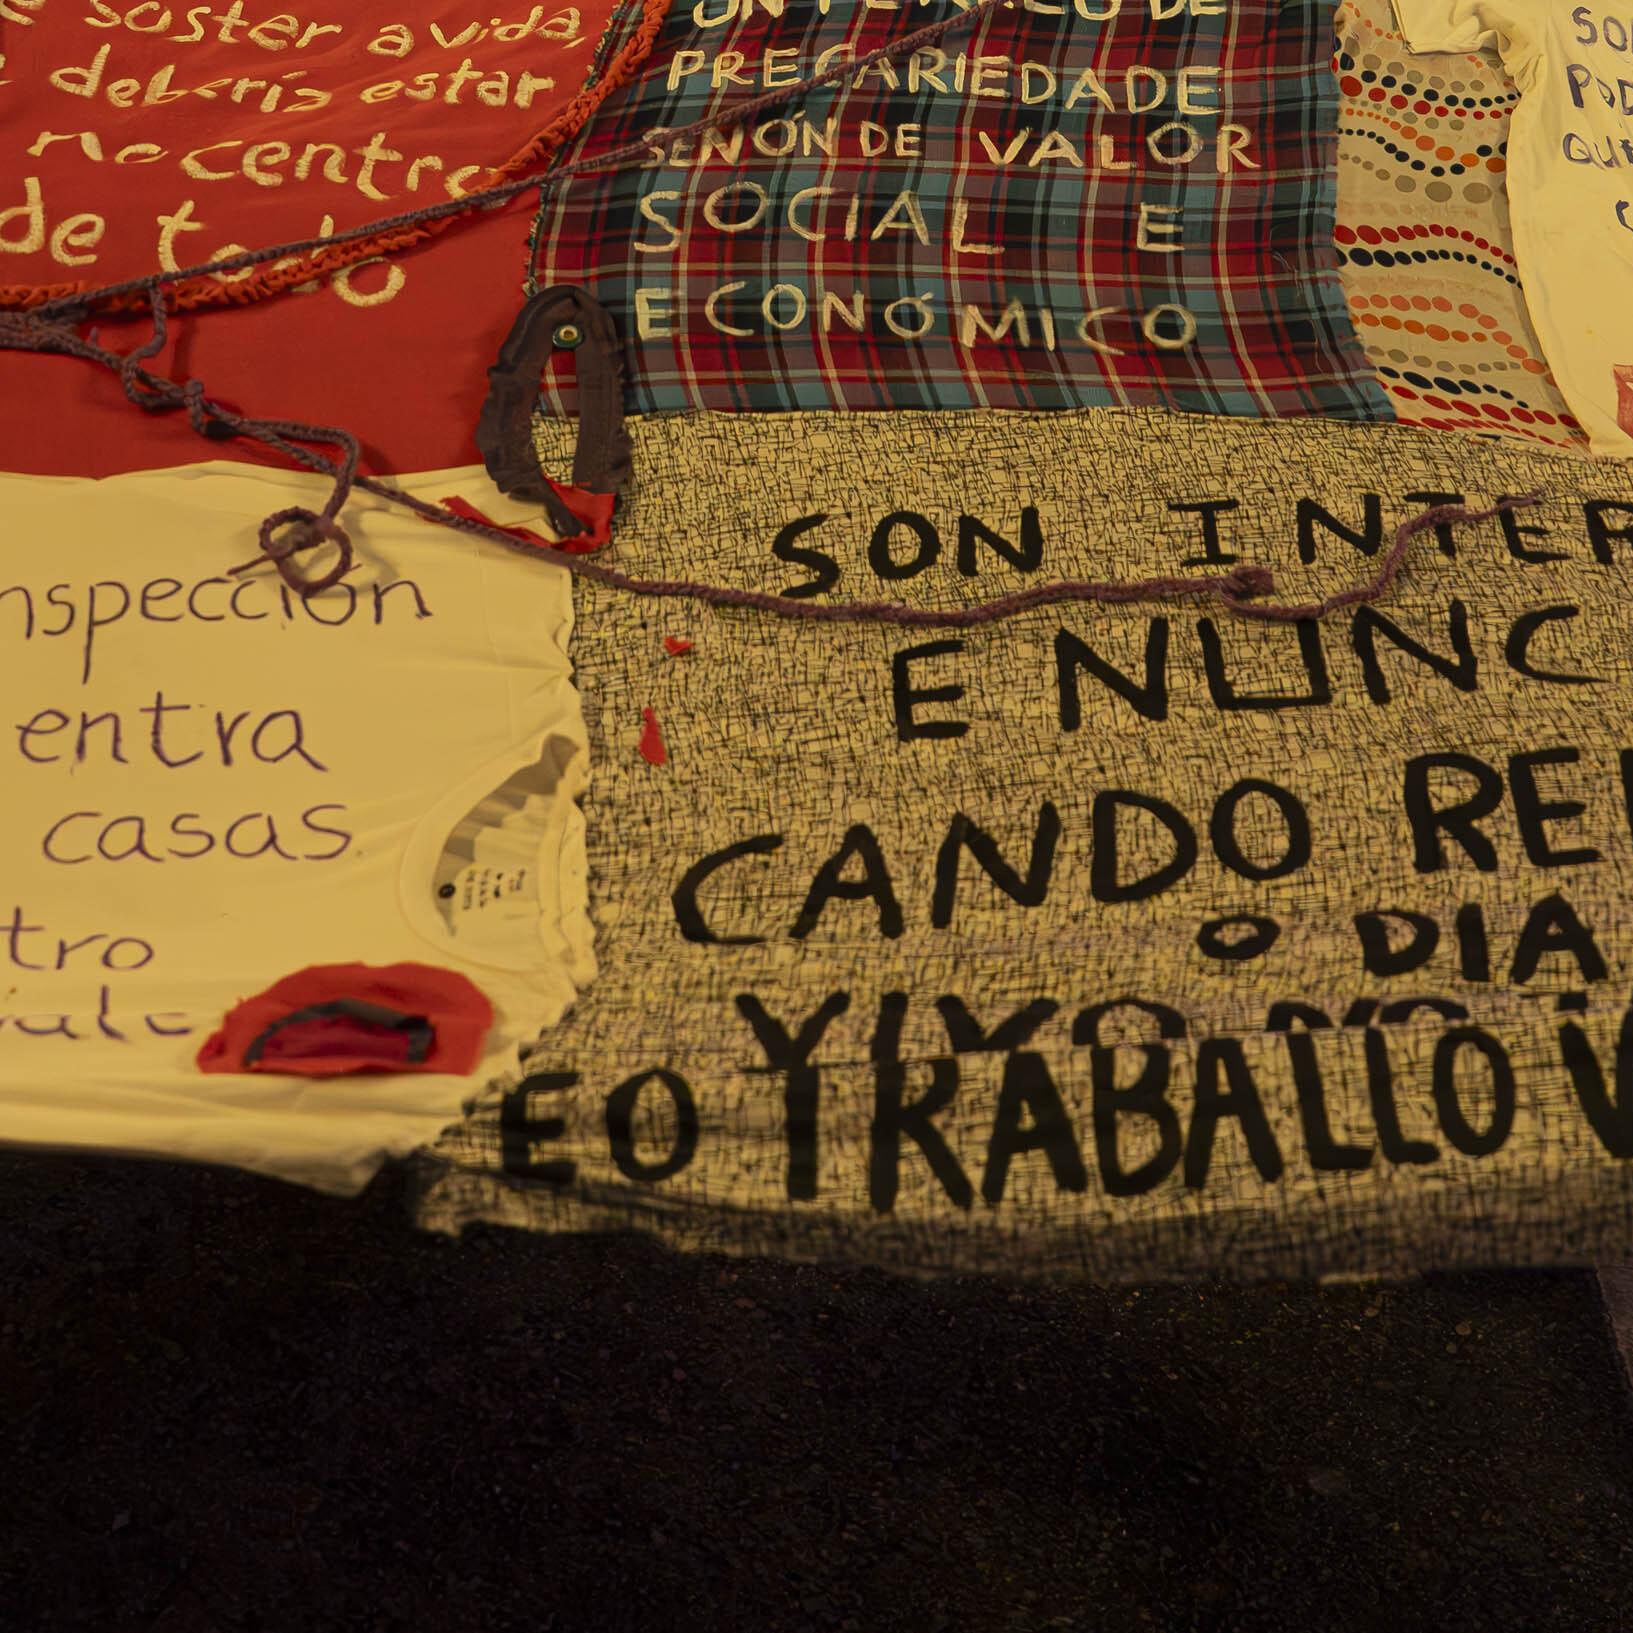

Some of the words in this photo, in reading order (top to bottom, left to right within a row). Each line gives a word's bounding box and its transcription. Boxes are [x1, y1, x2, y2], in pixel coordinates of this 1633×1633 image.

[368, 24, 415, 58] a
[359, 57, 557, 110] estar
[667, 43, 1222, 115] PRECARIEDADE
[859, 122, 925, 158] DE
[978, 121, 1262, 174] VALOR
[633, 181, 1006, 255] SOCIAL
[1137, 203, 1184, 253] E
[635, 280, 1198, 358] ECONÓMICO
[773, 506, 1044, 598] SON
[894, 639, 969, 742] E
[15, 690, 329, 773] entra
[42, 804, 353, 865] casas
[672, 778, 1313, 945] CANDO
[1196, 912, 1282, 962] O
